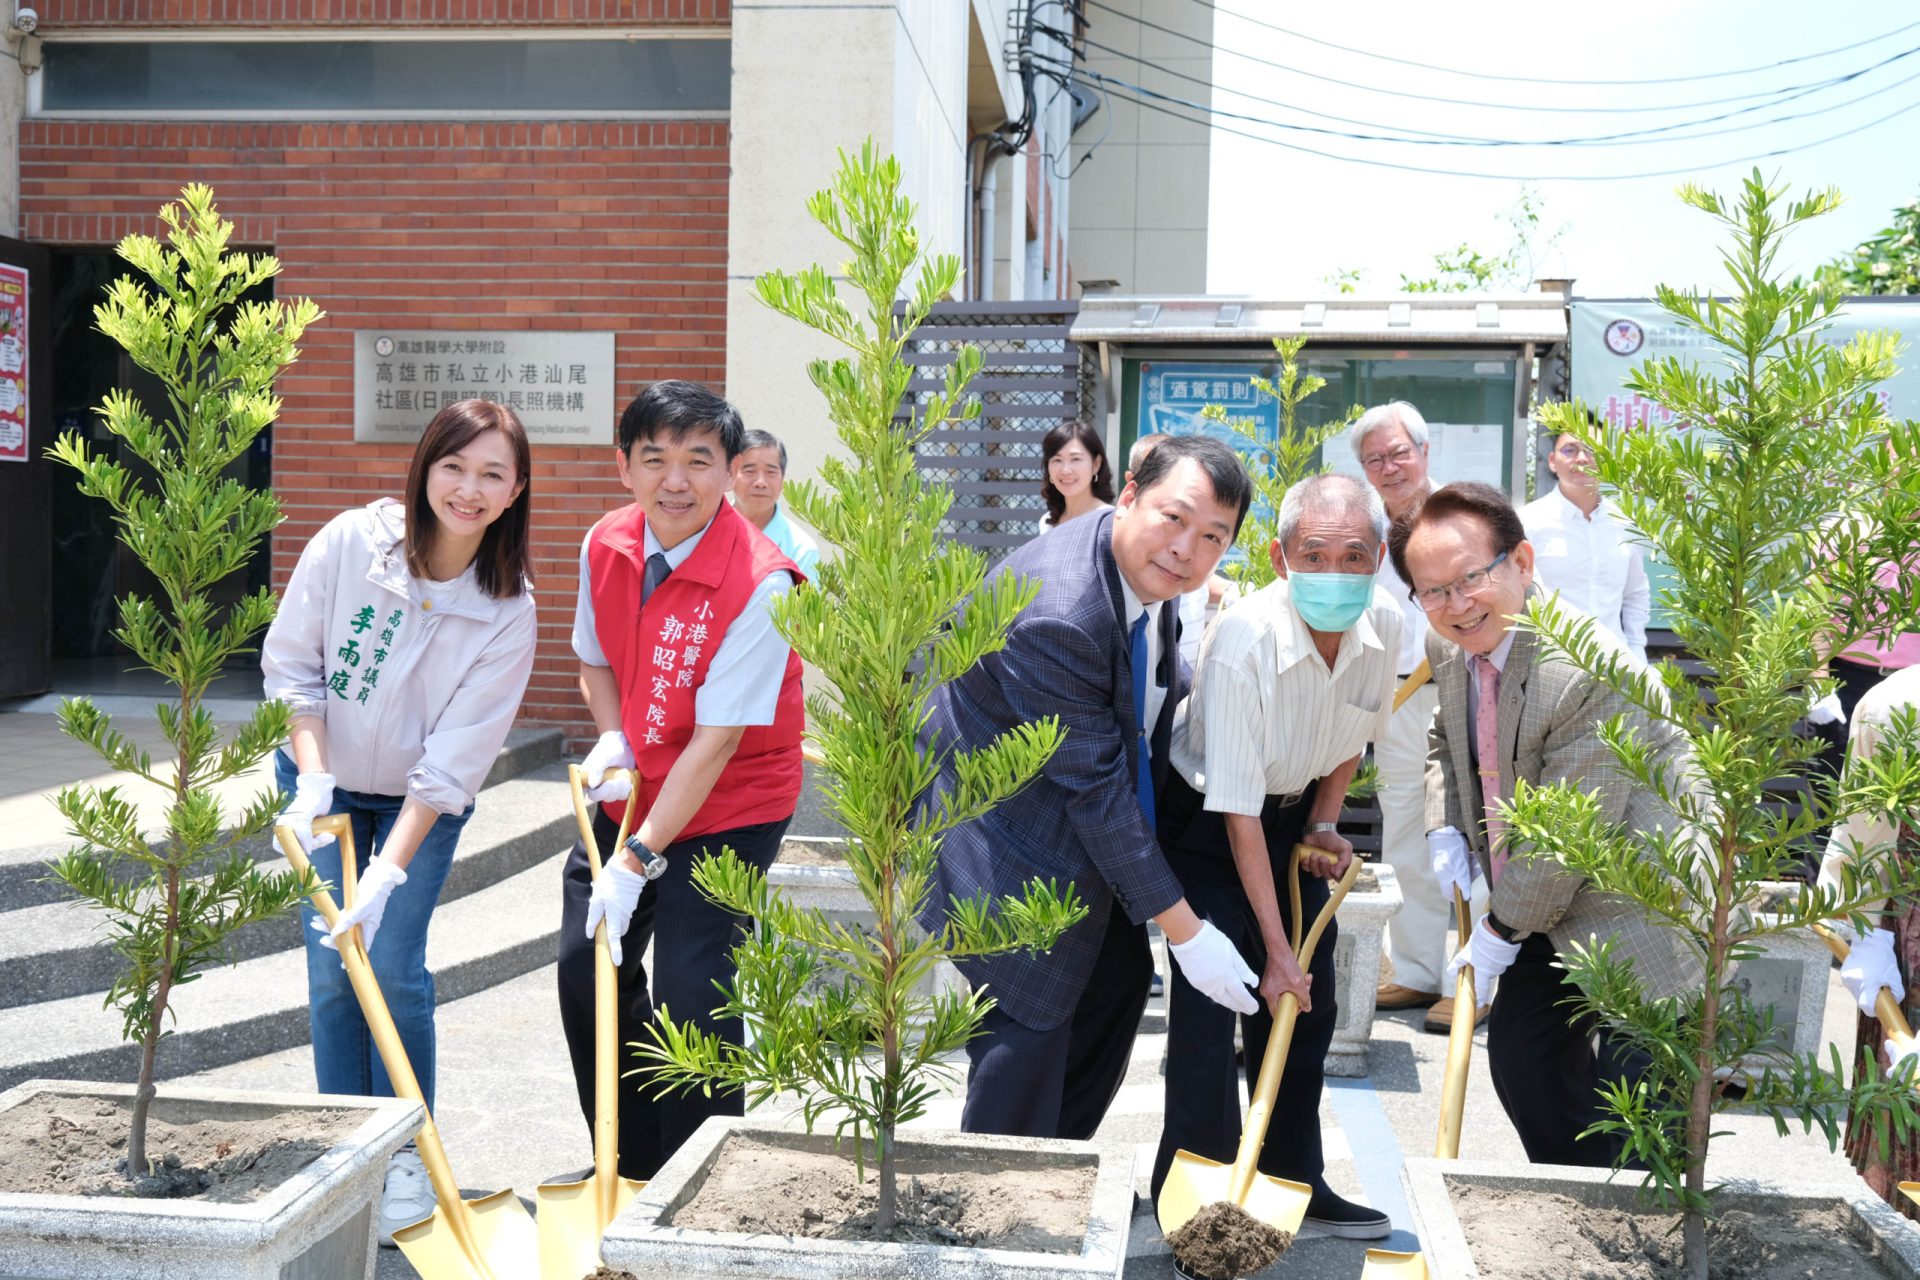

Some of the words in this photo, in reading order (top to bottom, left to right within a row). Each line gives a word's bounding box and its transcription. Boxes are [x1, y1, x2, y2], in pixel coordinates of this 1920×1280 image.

[375, 362, 588, 385] 高雄市私立小港汕尾
[397, 340, 507, 355] 高雄醫學大學附設
[1171, 381, 1250, 400] 酒駕罰則
[327, 604, 376, 701] 李雨庭
[355, 608, 404, 706] 高雄市議員
[675, 600, 714, 688] 小港醫院
